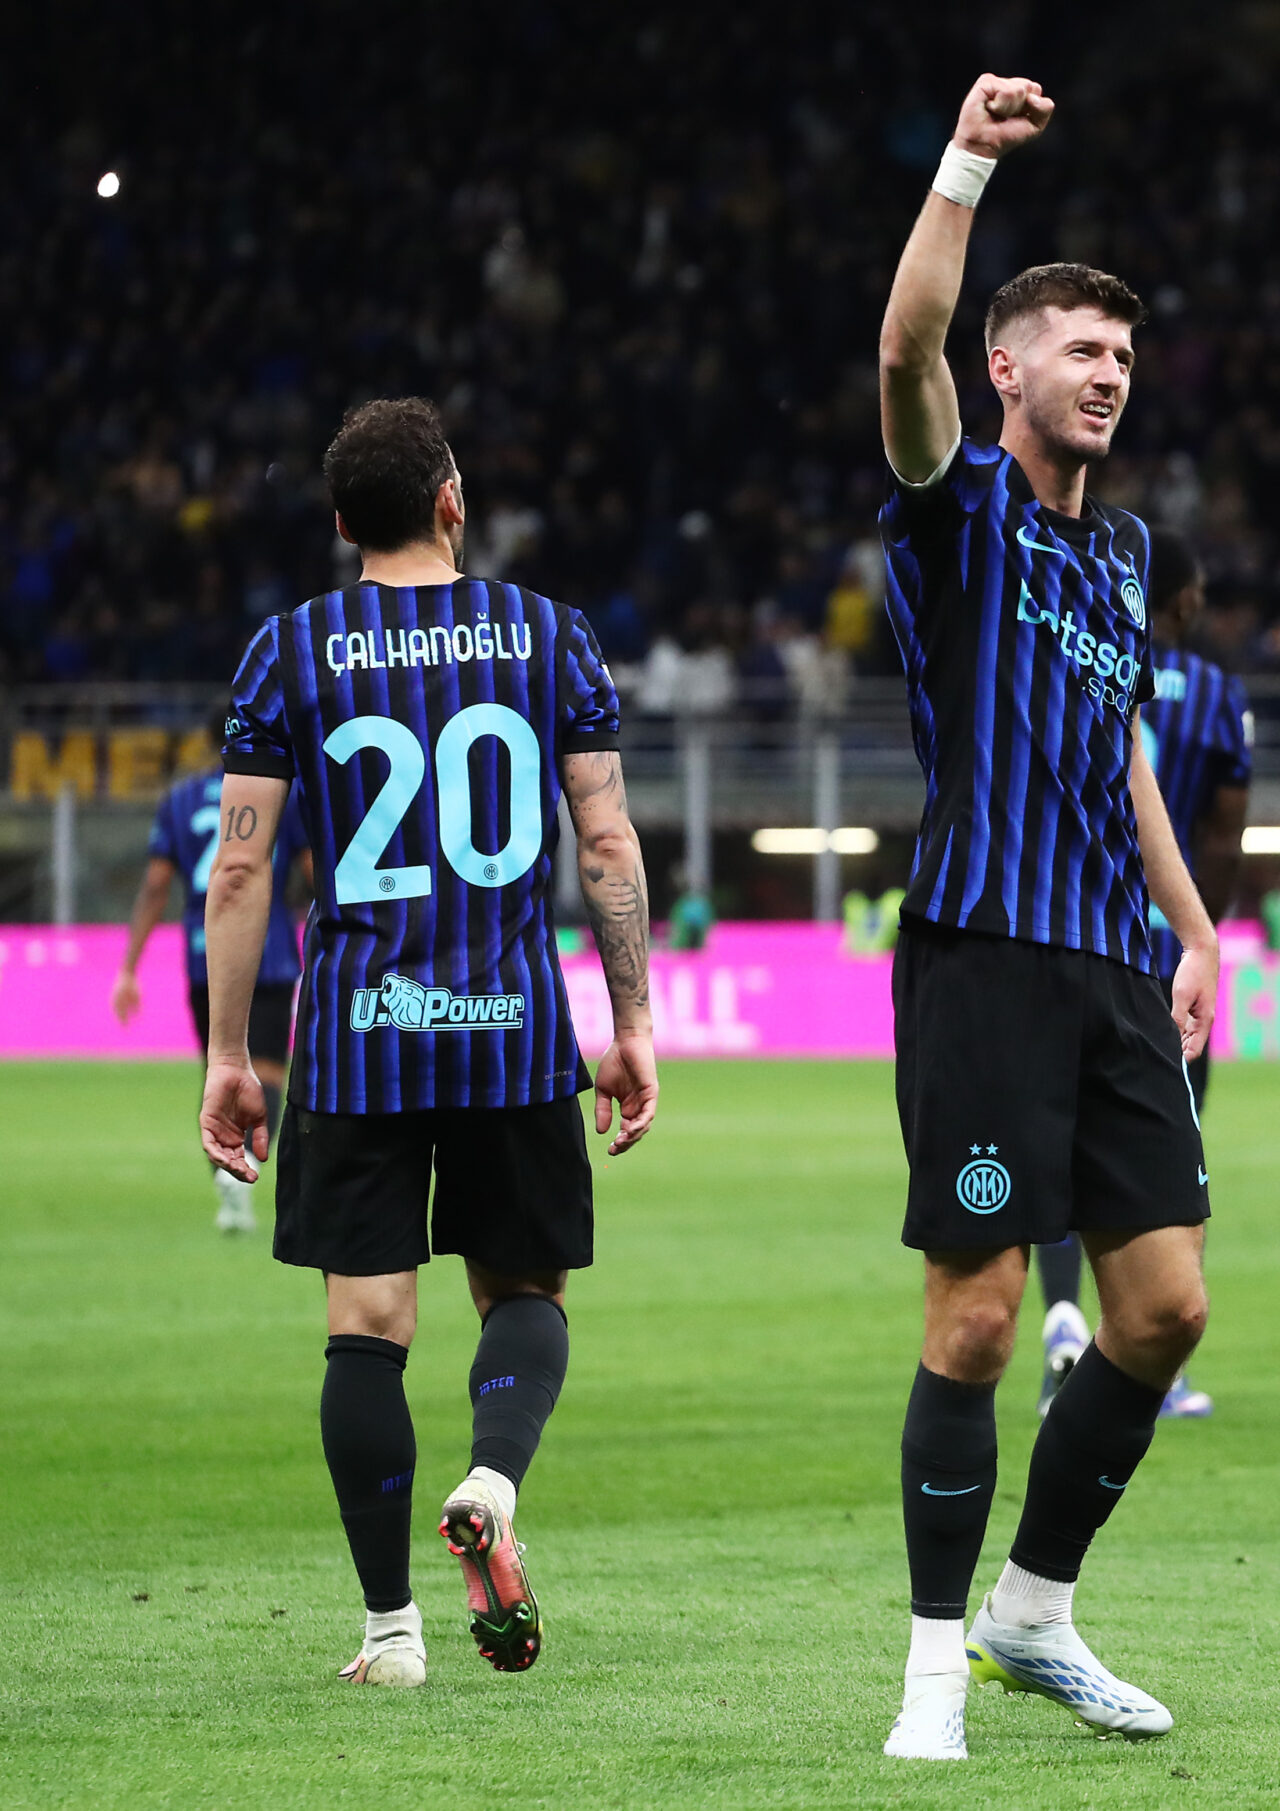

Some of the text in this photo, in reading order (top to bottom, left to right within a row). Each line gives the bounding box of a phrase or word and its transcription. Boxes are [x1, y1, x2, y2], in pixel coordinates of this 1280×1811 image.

[326, 612, 532, 677] ÇALHANOĞLU
[225, 805, 257, 842] 10
[322, 702, 543, 905] 20
[479, 1375, 516, 1396] INTER
